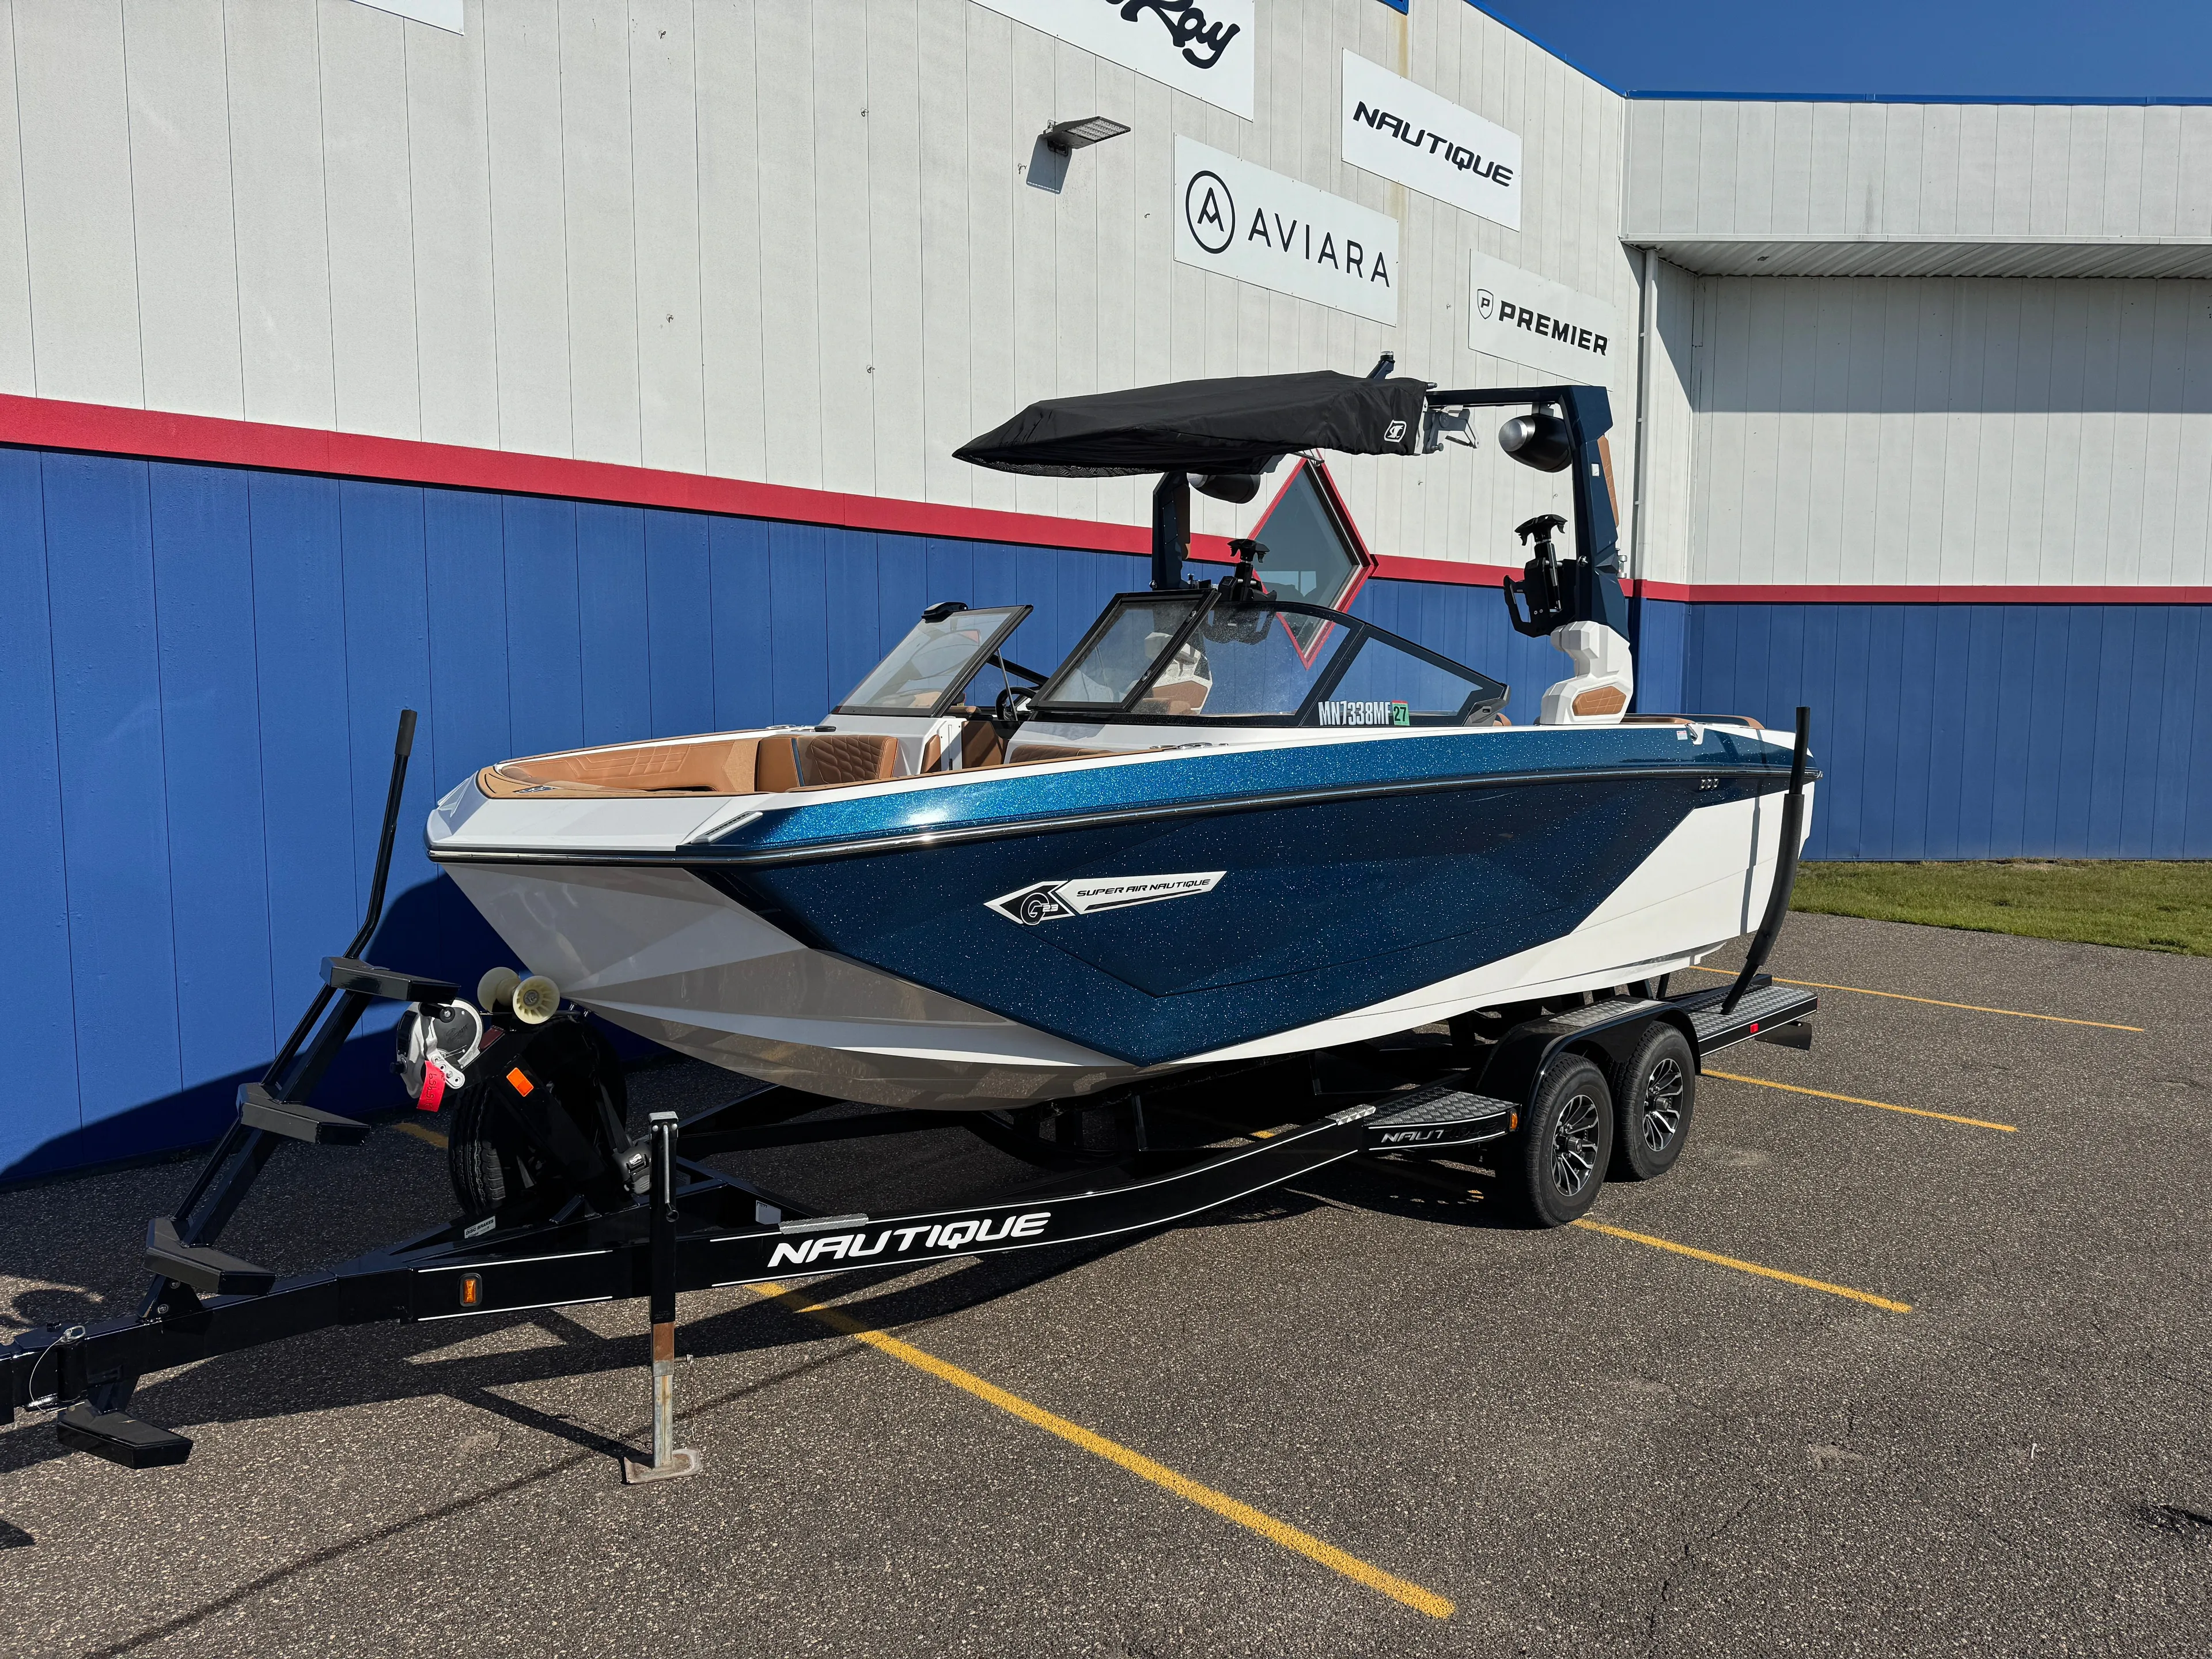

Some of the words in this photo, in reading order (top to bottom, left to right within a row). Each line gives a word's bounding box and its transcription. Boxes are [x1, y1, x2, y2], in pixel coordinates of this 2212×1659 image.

[1353, 101, 1514, 187] NAUTIQUE
[1248, 207, 1390, 288] AVIARA
[1498, 300, 1608, 356] PREMIER
[1318, 700, 1391, 726] MN7338MF
[1393, 706, 1407, 722] 27
[1076, 887, 1124, 897] SUPER
[1126, 885, 1148, 893] AIR
[1149, 879, 1211, 891] NAUTIQUE
[465, 1227, 477, 1236] DISC
[477, 1218, 494, 1230] BRAKES
[767, 1211, 1051, 1267] NAUTIQUE
